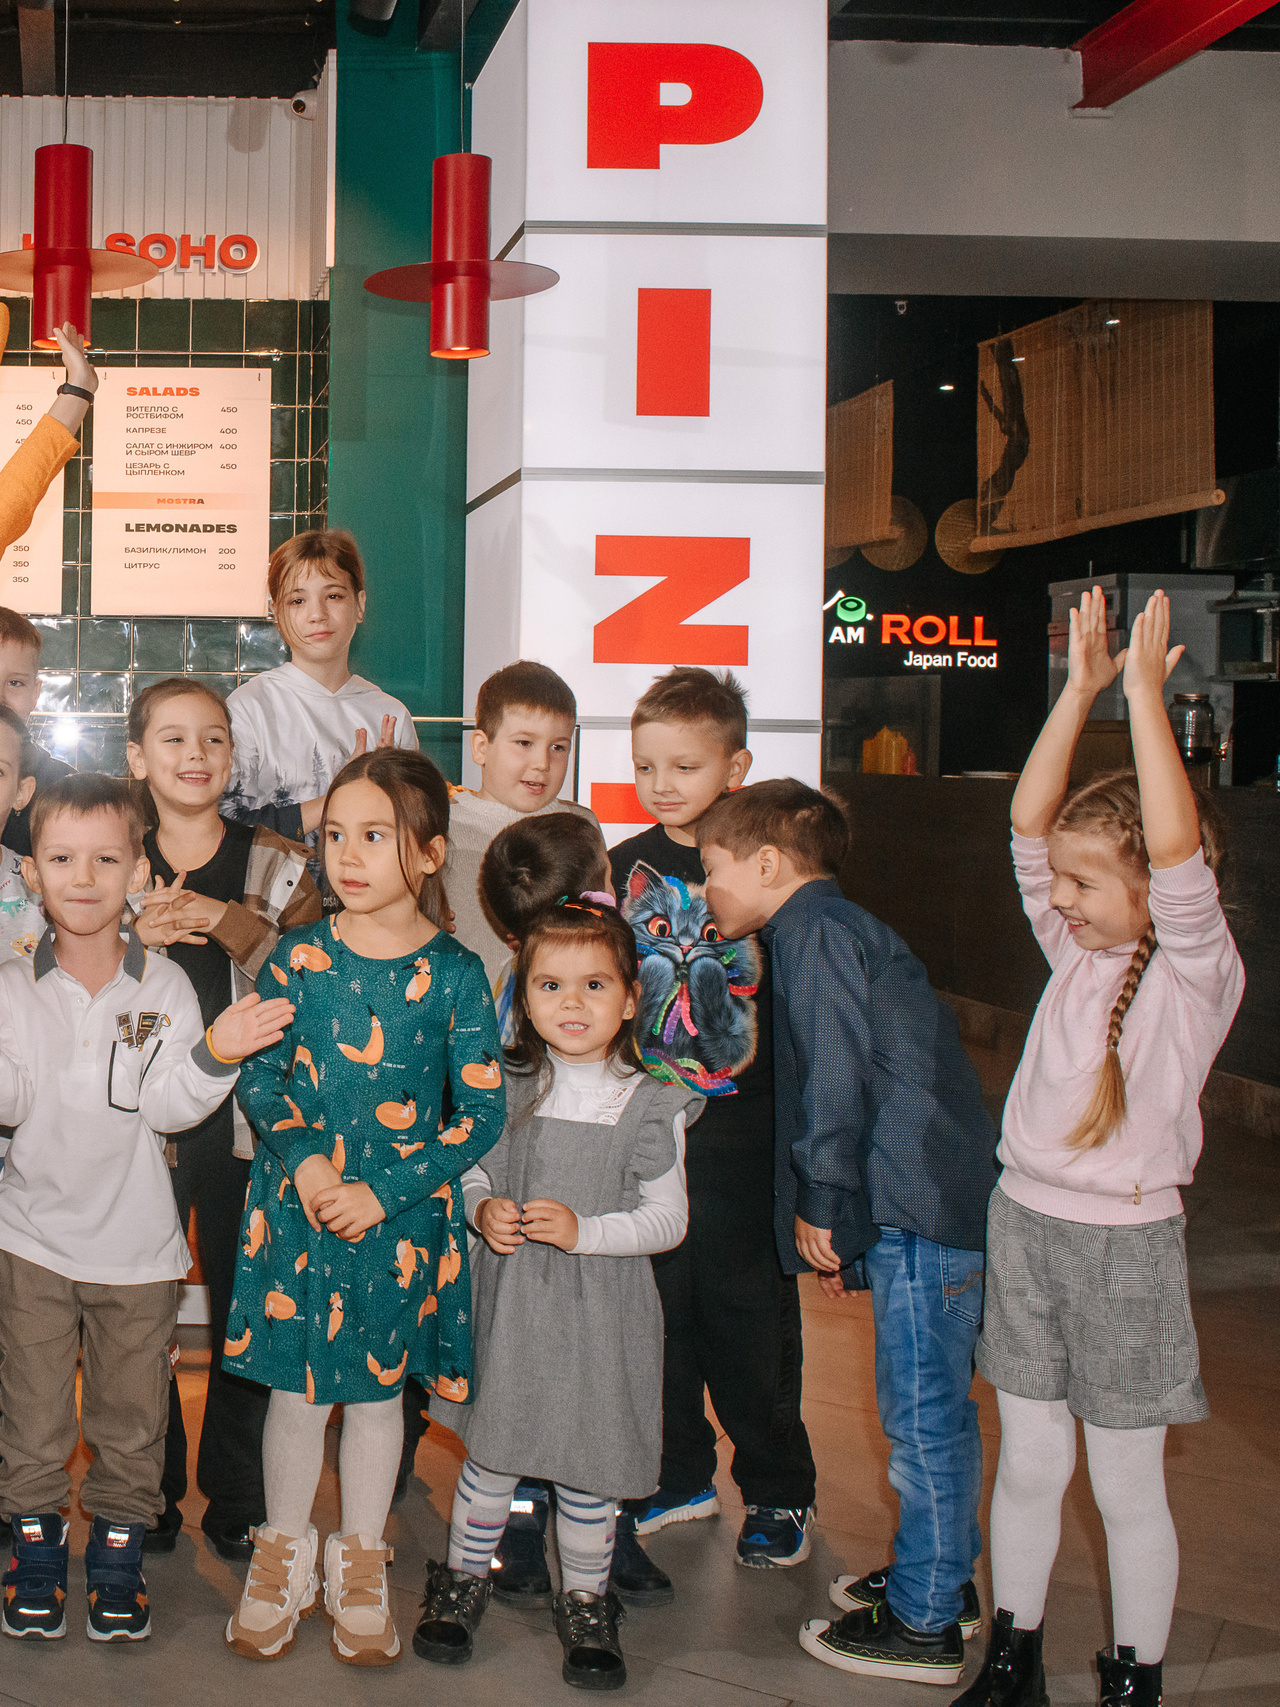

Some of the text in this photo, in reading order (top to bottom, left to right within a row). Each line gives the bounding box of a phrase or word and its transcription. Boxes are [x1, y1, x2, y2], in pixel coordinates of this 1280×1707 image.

[105, 232, 258, 270] SOHO
[126, 386, 200, 397] SALADS
[126, 405, 169, 413] ВИТЕЛЛО
[125, 469, 185, 477] ЦЫПЛЕНКОМ
[125, 523, 238, 533] LEMONADES
[881, 614, 998, 646] ROLL
[903, 650, 998, 670] Japan Food
